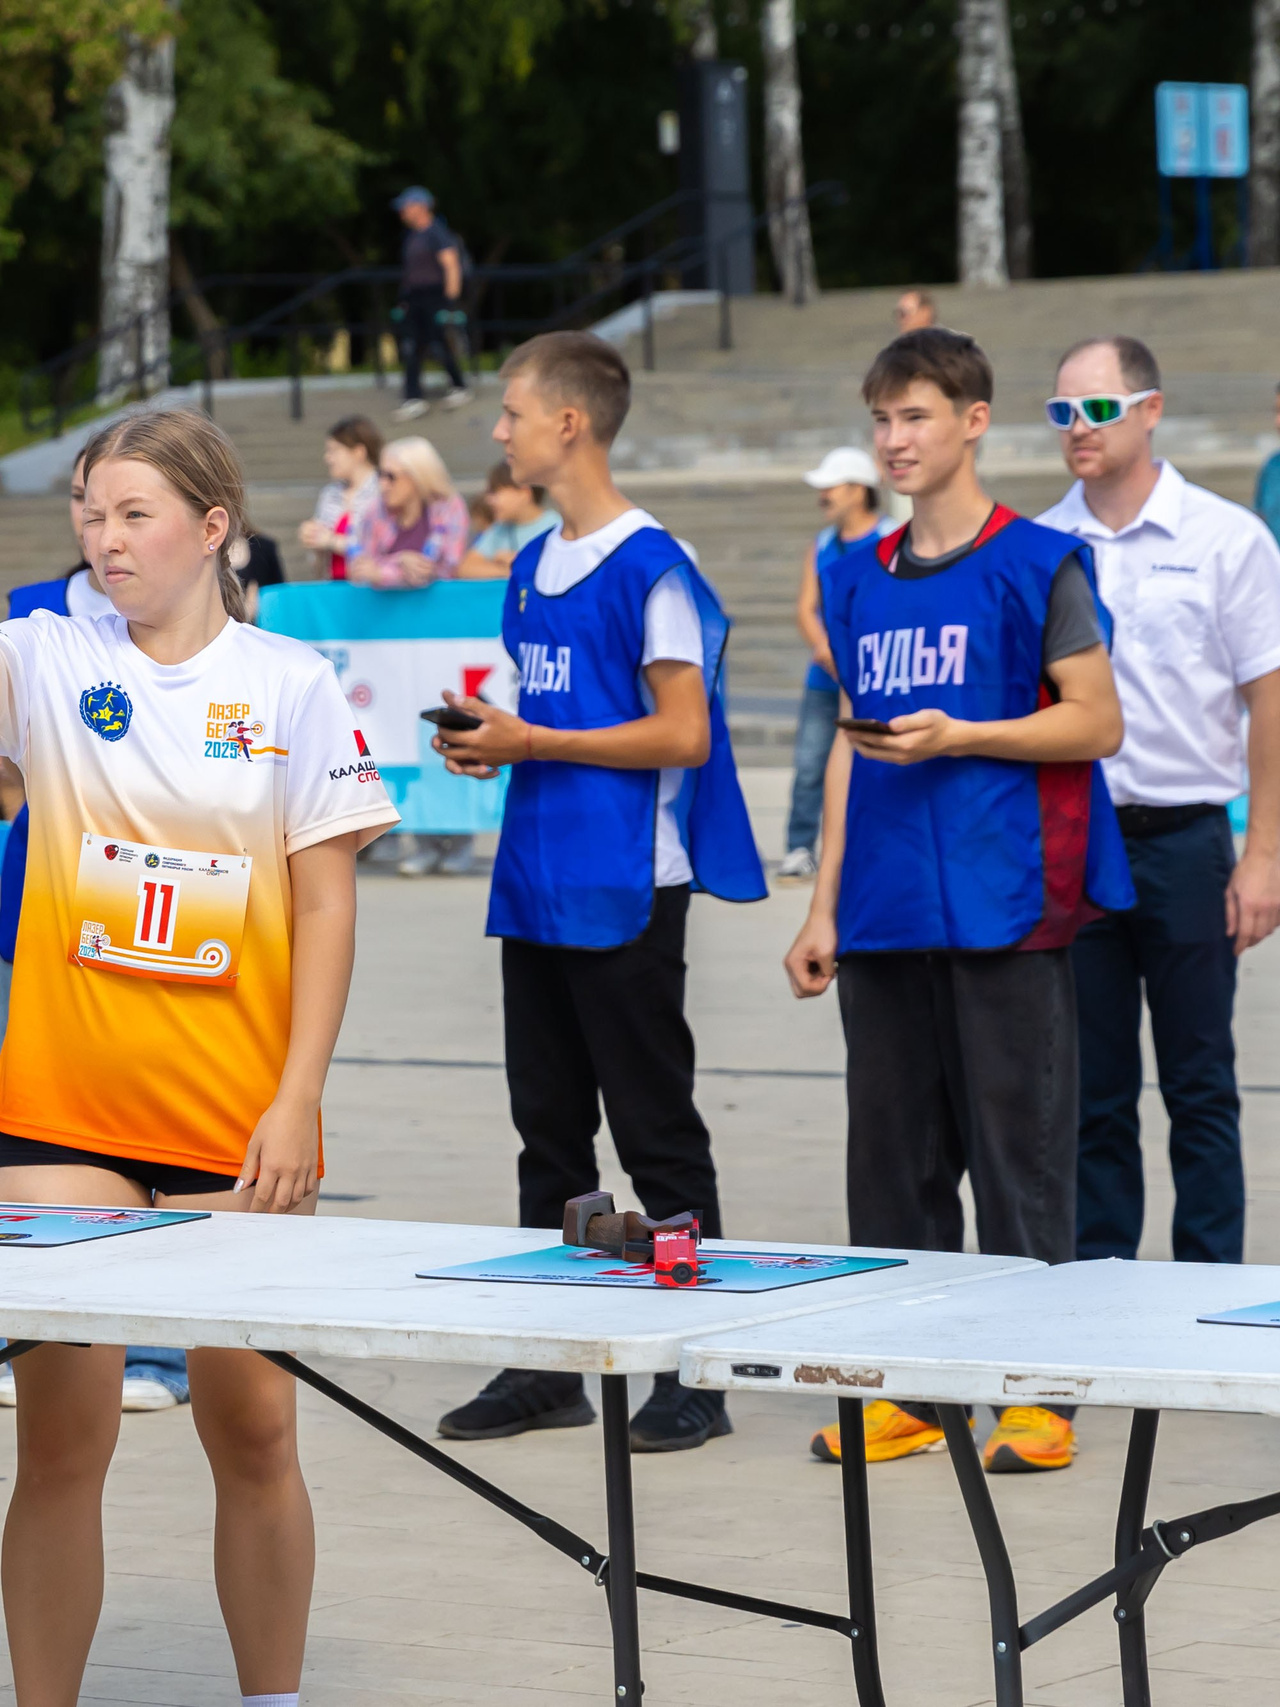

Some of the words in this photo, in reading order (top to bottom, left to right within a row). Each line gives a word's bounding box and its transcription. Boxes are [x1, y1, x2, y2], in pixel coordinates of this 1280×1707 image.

[857, 624, 968, 696] СУДЬЯ
[207, 702, 250, 720] ЛАЗЕР
[204, 740, 238, 760] 2025
[139, 880, 175, 945] 11
